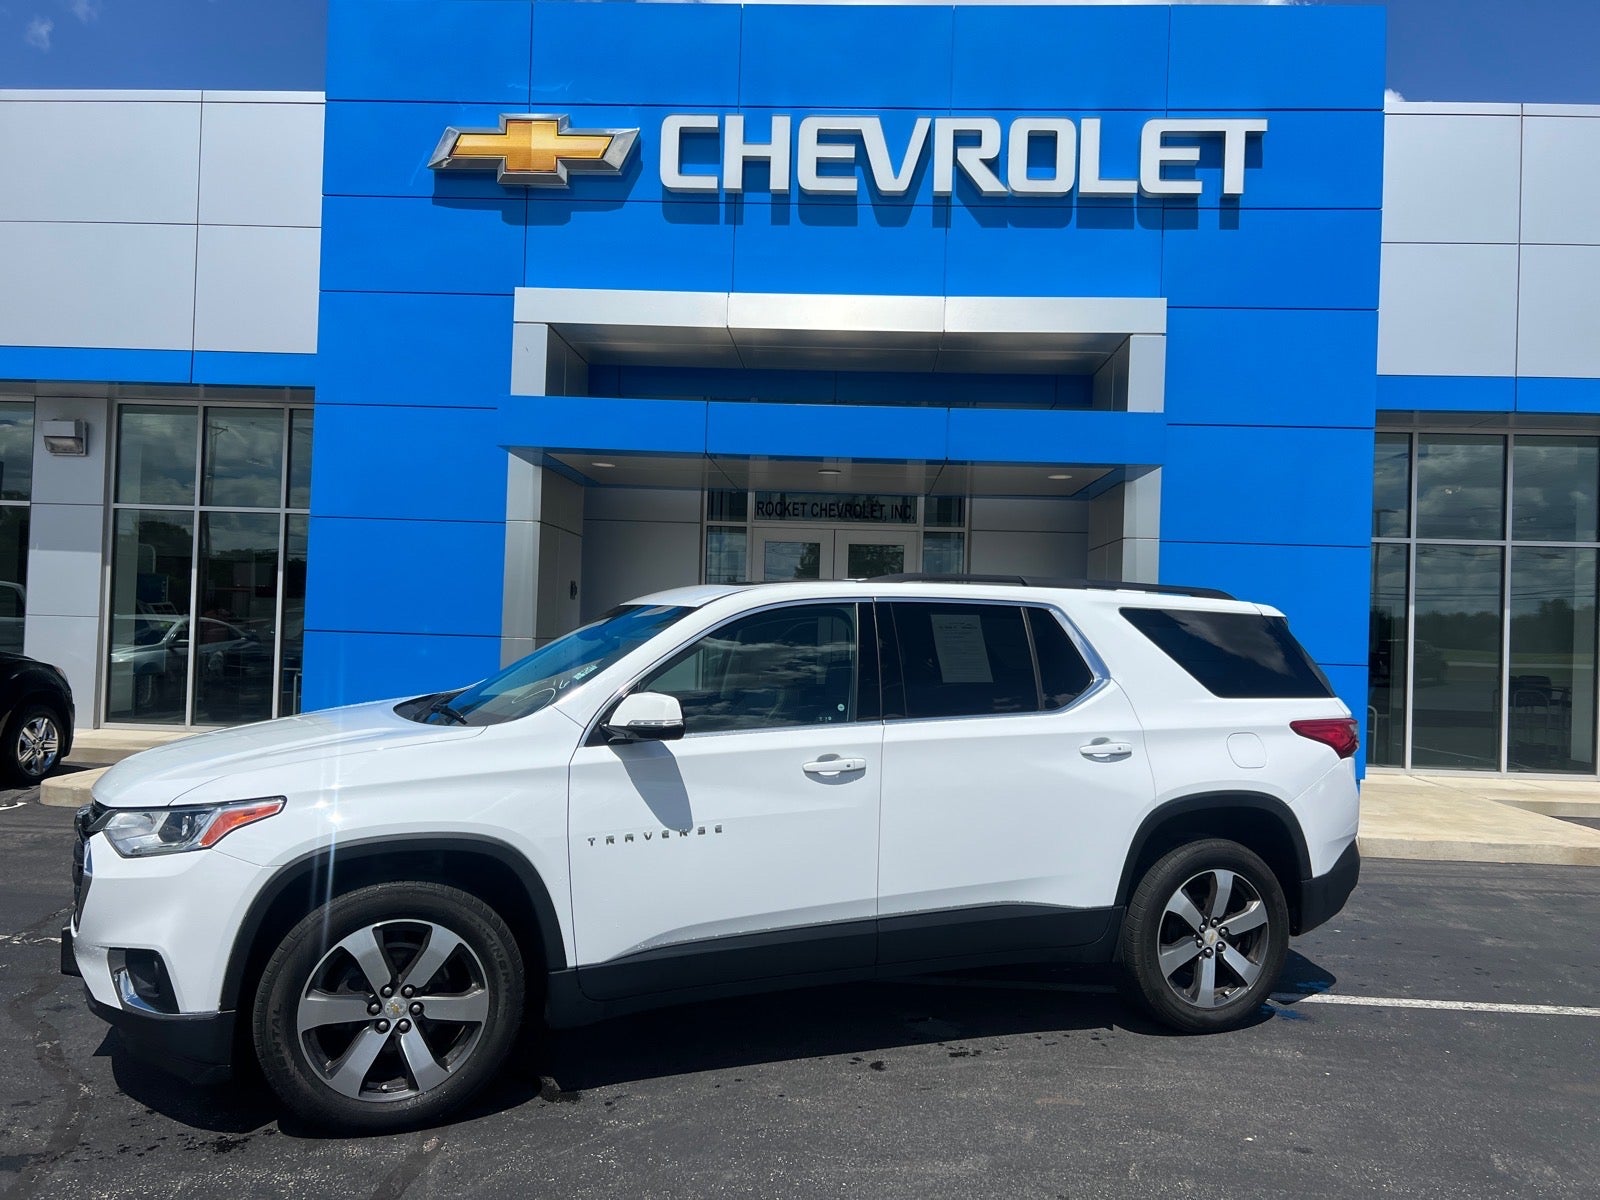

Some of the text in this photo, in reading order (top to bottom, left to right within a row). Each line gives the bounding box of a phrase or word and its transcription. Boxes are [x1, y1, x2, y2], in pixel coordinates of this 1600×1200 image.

[659, 114, 1268, 197] CHEVROLET
[756, 501, 807, 517] ROCKET
[890, 503, 915, 520] INC.
[587, 824, 723, 846] TRAVERSE
